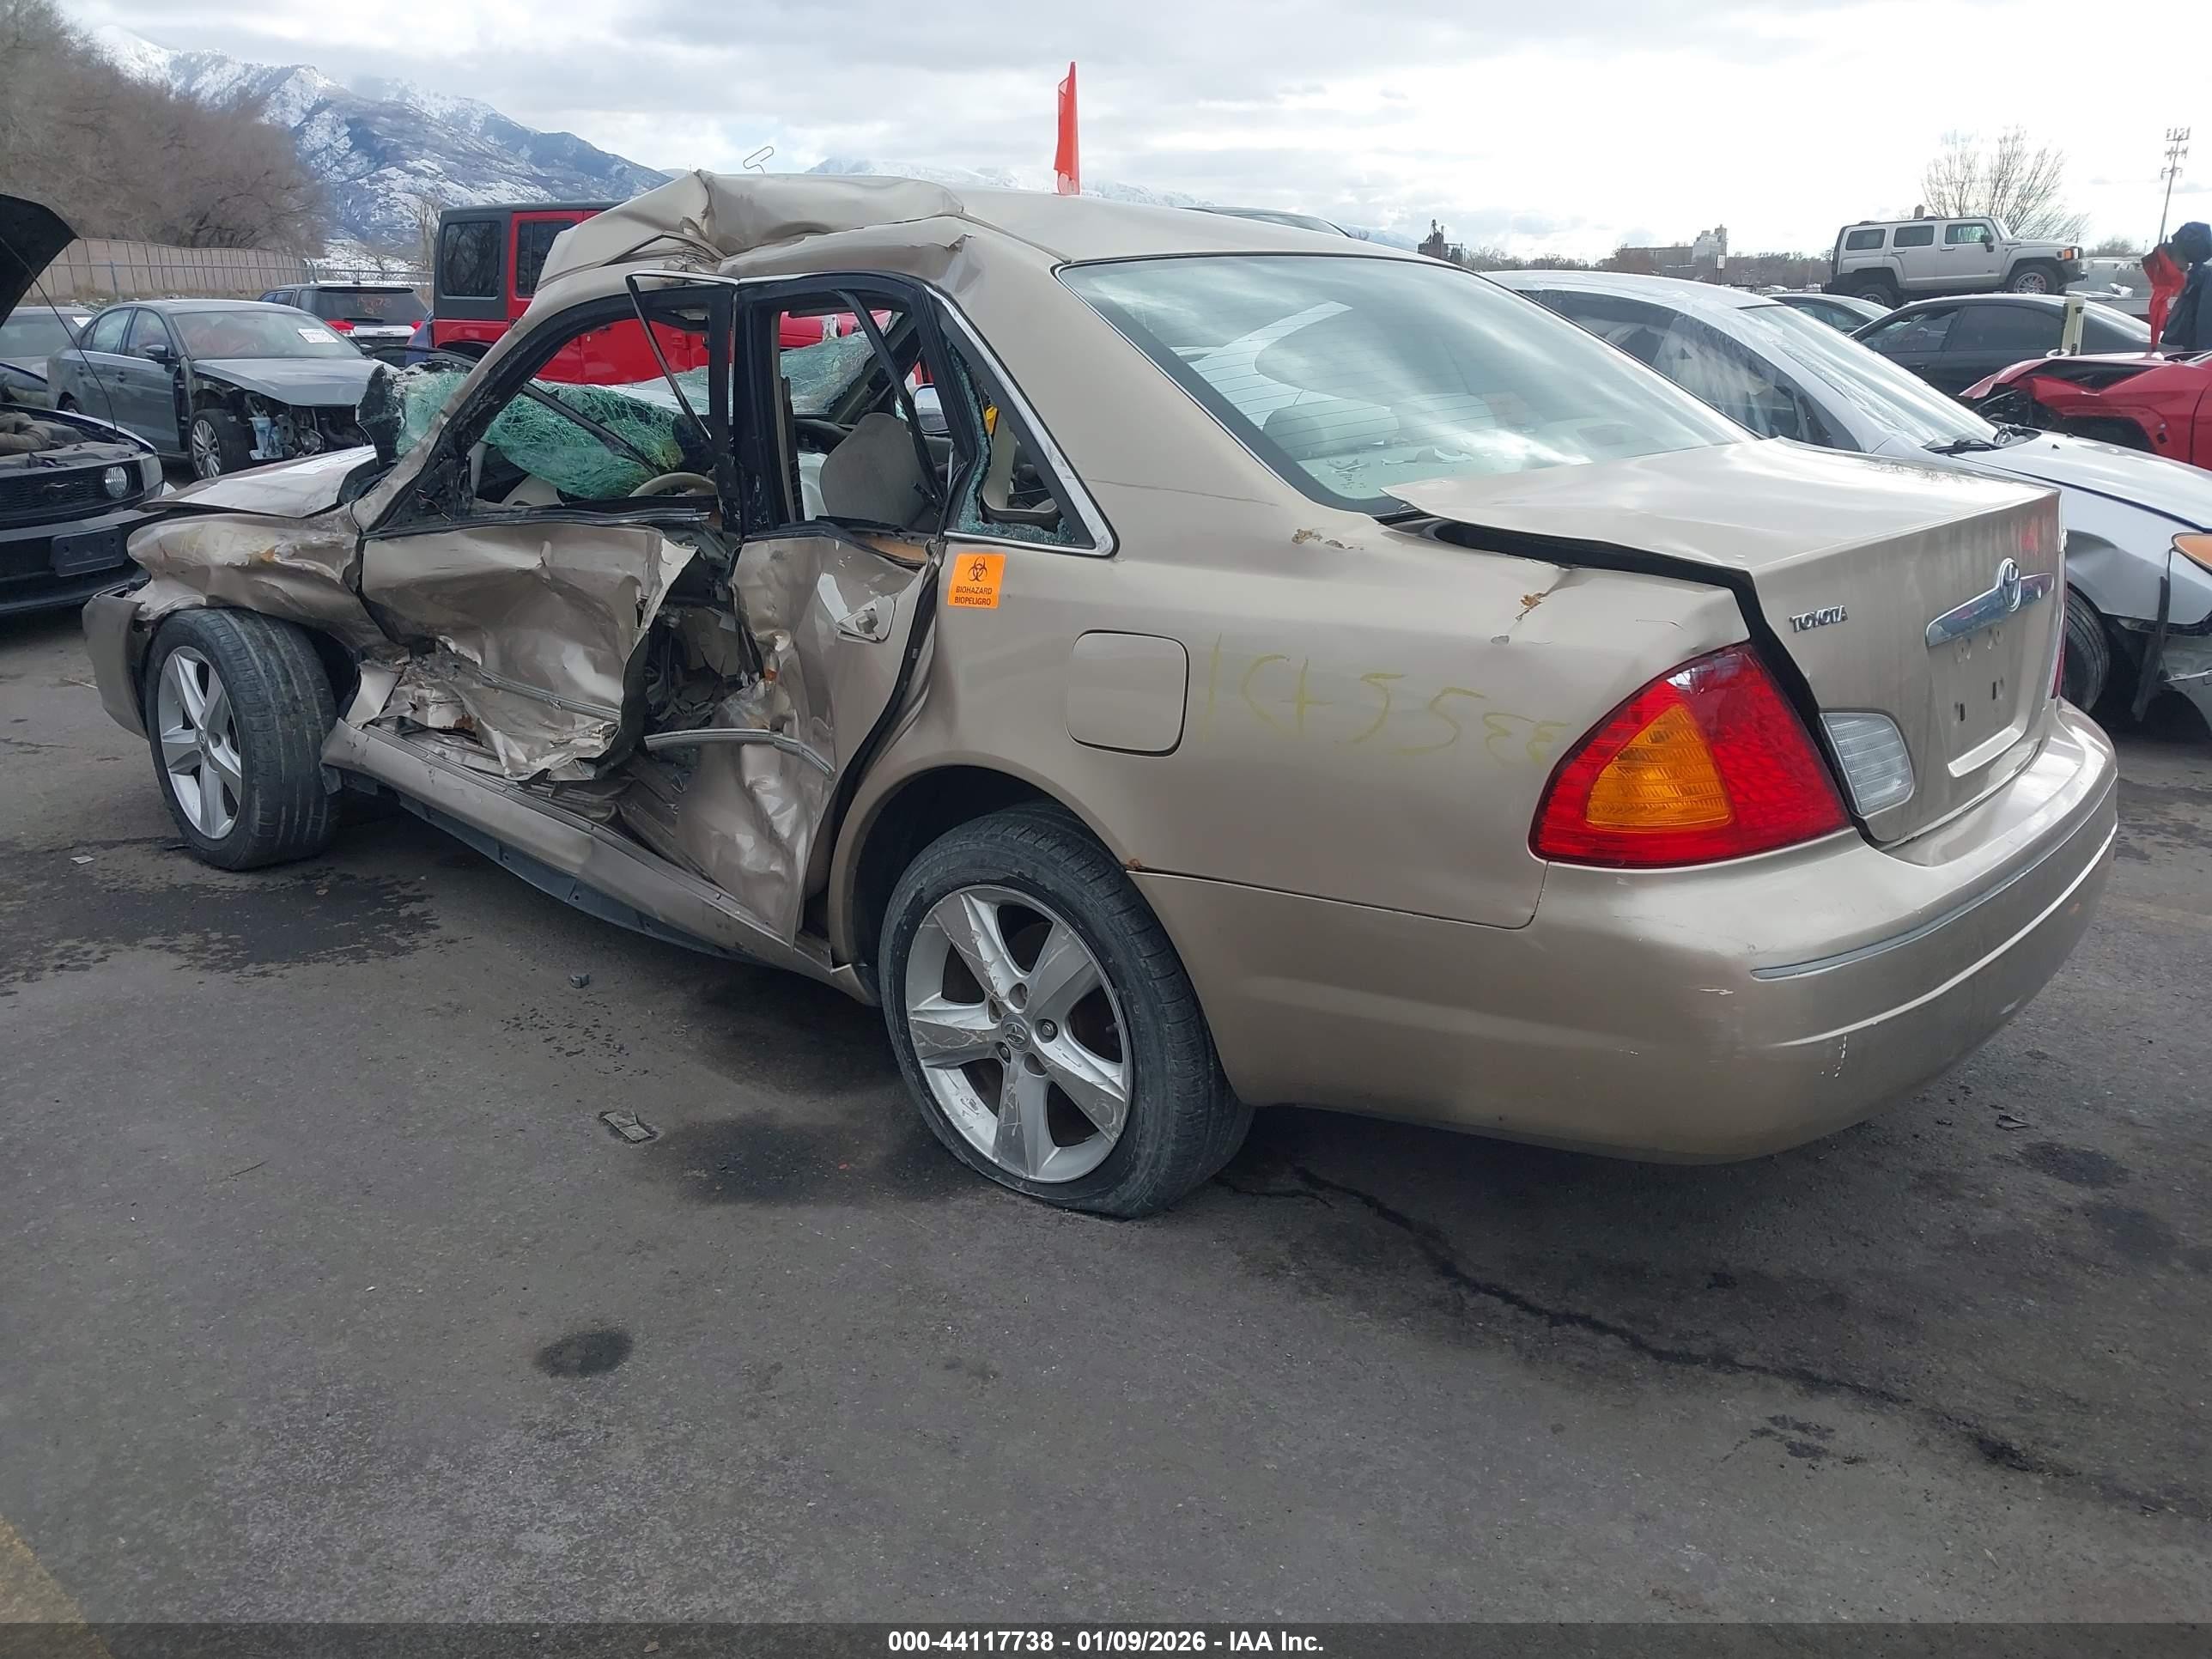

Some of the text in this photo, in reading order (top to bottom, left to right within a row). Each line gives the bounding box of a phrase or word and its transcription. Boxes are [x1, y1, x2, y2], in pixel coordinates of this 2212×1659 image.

[956, 586, 993, 595] BIOHAZARD
[954, 596, 992, 605] BIOPELIGRO
[1789, 605, 1848, 633] TOYOTA
